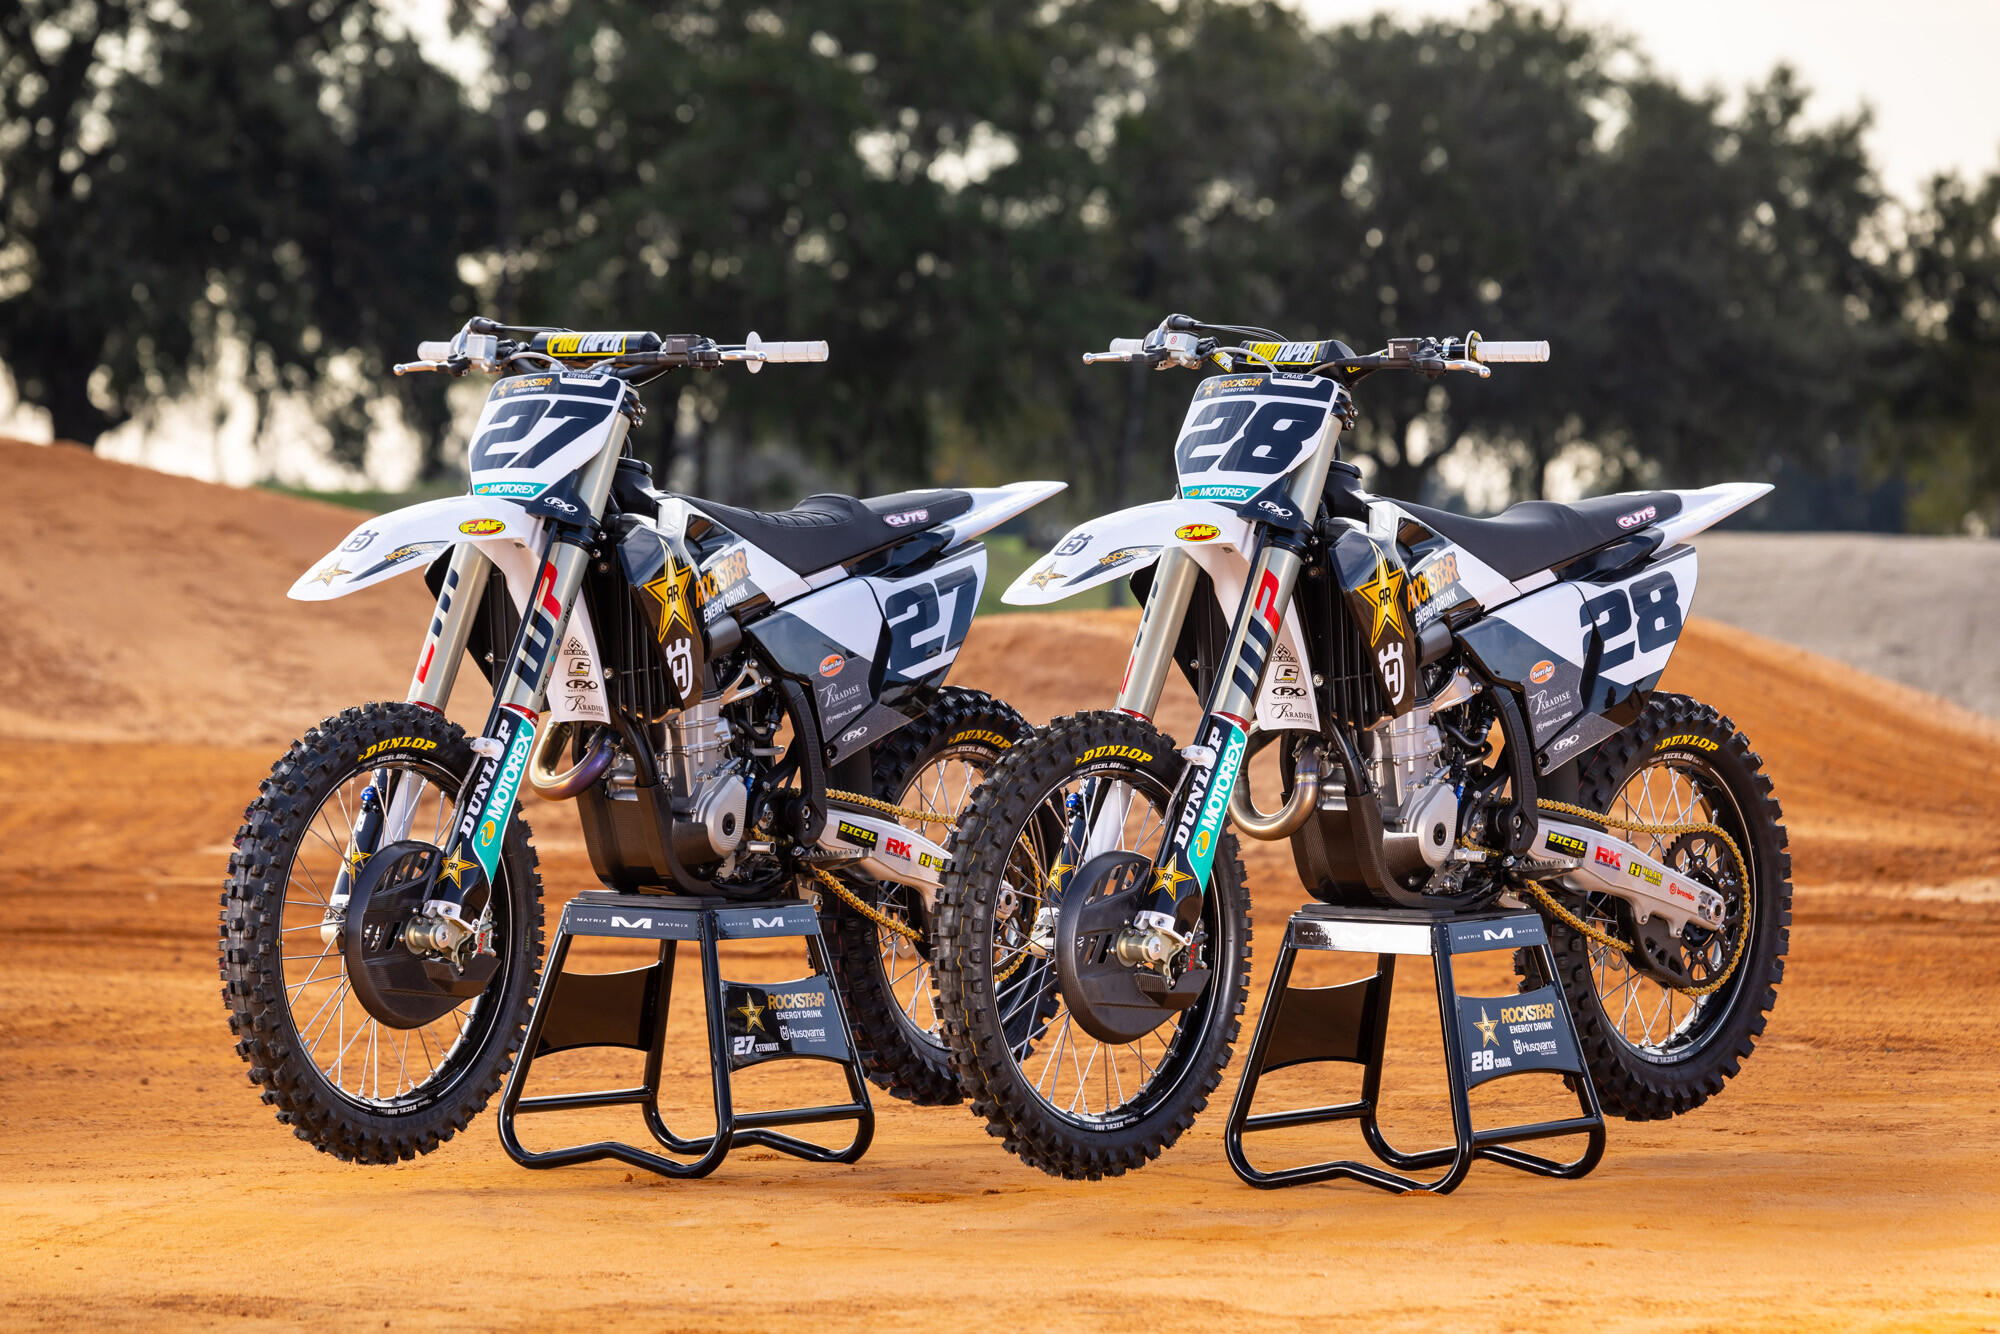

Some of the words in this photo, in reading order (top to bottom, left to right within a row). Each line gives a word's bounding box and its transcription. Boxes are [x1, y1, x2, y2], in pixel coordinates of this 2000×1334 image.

[512, 378, 552, 389] ROCKSTAR
[566, 372, 596, 380] STEWART
[1220, 378, 1263, 389] ROCKSTAR
[472, 399, 614, 472] 27
[1177, 400, 1328, 474] 28
[489, 484, 536, 494] MOTOREX
[1200, 487, 1248, 498] MOTOREX
[885, 510, 928, 527] GUTS
[1618, 506, 1656, 528] GUTS
[461, 520, 503, 533] FMF
[1178, 526, 1218, 539] FMF
[695, 551, 750, 608] ROCKSTAR
[1407, 553, 1460, 612] ROCKSTAR
[703, 598, 725, 622] ENERGY
[725, 583, 748, 608] DRINK
[1415, 602, 1436, 627] ENERGY
[1435, 588, 1458, 613] DRINK
[885, 565, 978, 673] 27
[1579, 570, 1683, 673] 28
[1531, 668, 1545, 680] Twin
[1545, 664, 1553, 674] Air
[564, 695, 605, 712] PARADISE
[818, 683, 861, 708] PARADISE
[1528, 690, 1572, 715] PARADISE
[1270, 702, 1313, 720] PARADISE
[363, 736, 437, 760] DUNLOP
[952, 729, 1012, 749] DUNLOP
[1658, 734, 1719, 752] DUNLOP
[957, 745, 976, 753] EXCEL
[1080, 744, 1153, 764] DUNLOP
[1663, 752, 1681, 760] EXCEL
[377, 754, 395, 763] EXCEL
[1090, 763, 1108, 771] EXCEL
[460, 719, 511, 839] DUNLP
[487, 731, 533, 822] MOTOREX
[1201, 738, 1245, 831] MOTOREX
[1174, 727, 1221, 850] DUNLP
[839, 822, 876, 843] EXCEL
[885, 837, 913, 858] RK
[1548, 832, 1586, 852] EXCEL
[932, 856, 943, 868] HA
[1594, 846, 1623, 868] RK
[1642, 866, 1664, 881] HAAN
[1676, 887, 1695, 901] brembo
[767, 992, 826, 1010] ROCKSTAR
[776, 1011, 801, 1020] ENERGY
[801, 1009, 823, 1019] DRINK
[1500, 1003, 1555, 1024] ROCKSTAR
[789, 1027, 825, 1040] Husqvarna
[1509, 1024, 1533, 1034] ENERGY
[1533, 1021, 1553, 1031] DRINK
[733, 1036, 756, 1056] 27
[755, 1042, 780, 1053] STEWART
[1521, 1040, 1557, 1053] Husqvarna
[1471, 1049, 1494, 1072] 28
[1494, 1057, 1512, 1068] CRAIG
[399, 1104, 417, 1114] EXCEL
[1105, 1121, 1124, 1130] EXCEL
